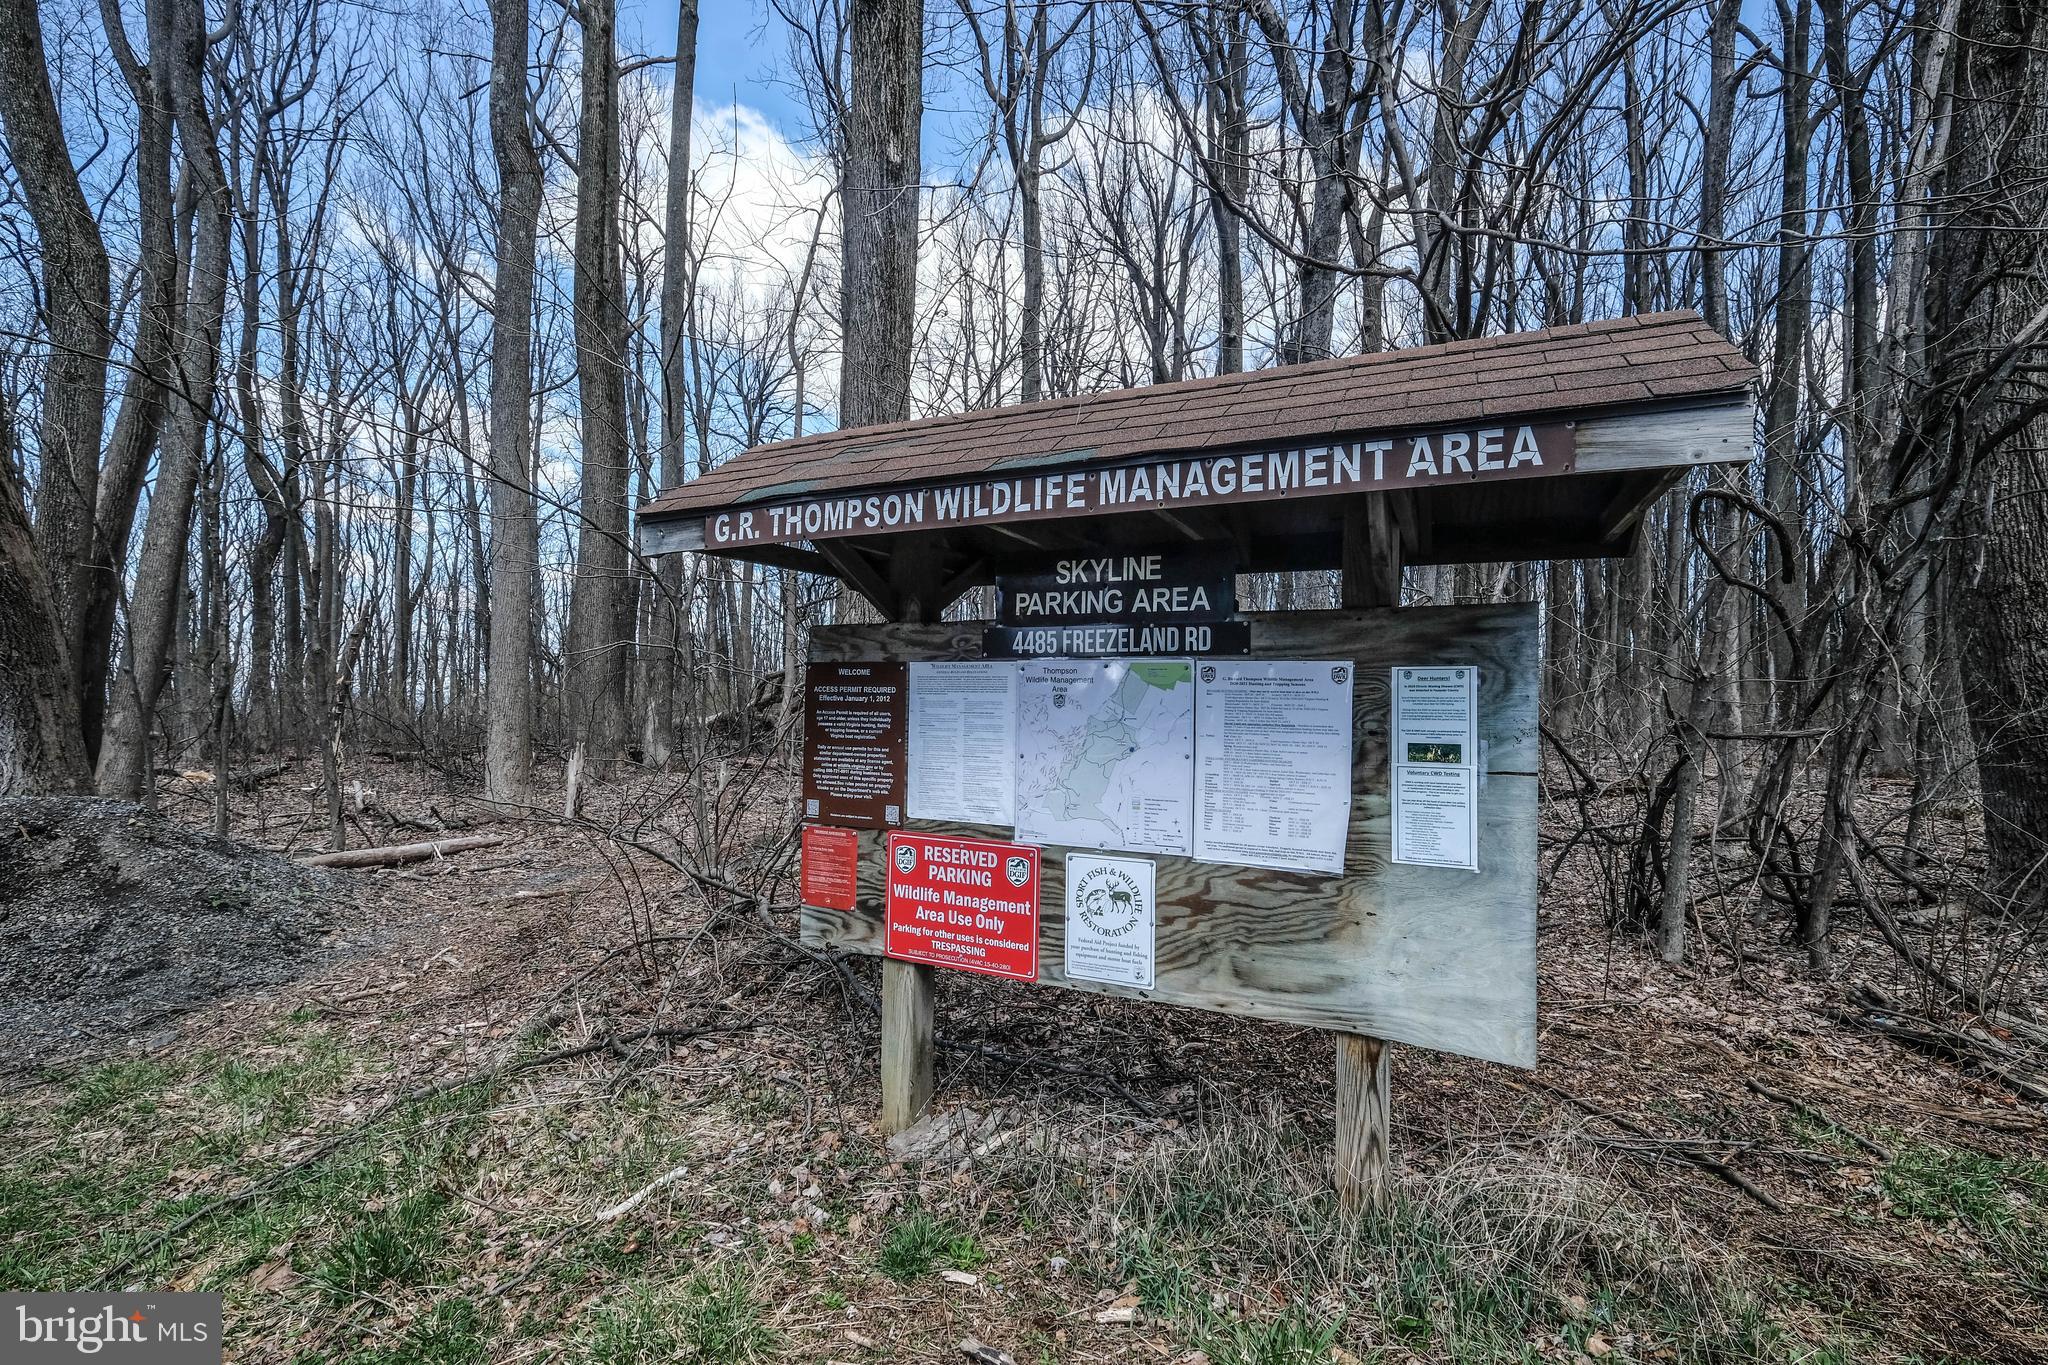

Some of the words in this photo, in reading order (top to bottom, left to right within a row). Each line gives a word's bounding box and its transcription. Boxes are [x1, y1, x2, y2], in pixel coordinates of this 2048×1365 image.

[714, 511, 759, 543] G.R.
[769, 492, 924, 537] THOMPSON
[933, 473, 1085, 520] WILDLIFE
[1100, 440, 1393, 505] MANAGEMENT
[1406, 425, 1544, 478] AREA
[1056, 555, 1162, 584] SKYLINE
[1015, 589, 1122, 616] PARKING
[1132, 586, 1211, 613] AREA
[1013, 630, 1057, 654] 4485
[1062, 627, 1179, 653] FREEZELAND
[1185, 627, 1211, 651] RD
[1026, 675, 1049, 684] Wildlife
[1050, 676, 1094, 685] Management
[1042, 667, 1078, 675] Thompson
[1052, 685, 1067, 693] Area
[924, 845, 998, 868] RESERVED
[929, 865, 992, 887] PARKING
[894, 884, 940, 902] Wildlife
[944, 891, 1031, 915] Management
[1076, 877, 1088, 909] SPORT
[1087, 867, 1107, 880] FISH
[1109, 868, 1116, 876] &
[1118, 871, 1142, 914] WILDLIFE
[915, 906, 944, 923] Area
[949, 911, 972, 926] Use
[976, 914, 1005, 934] Only
[1080, 911, 1139, 937] RESTORATION
[893, 923, 922, 936] Parking
[923, 927, 933, 937] for
[935, 930, 955, 940] other
[957, 934, 974, 942] uses
[976, 935, 983, 944] is
[984, 937, 1029, 951] considered
[932, 940, 986, 957] TRESPASSING
[908, 949, 928, 957] SUBJECT
[936, 952, 969, 964] PROSECUTION
[1106, 948, 1122, 956] hunting
